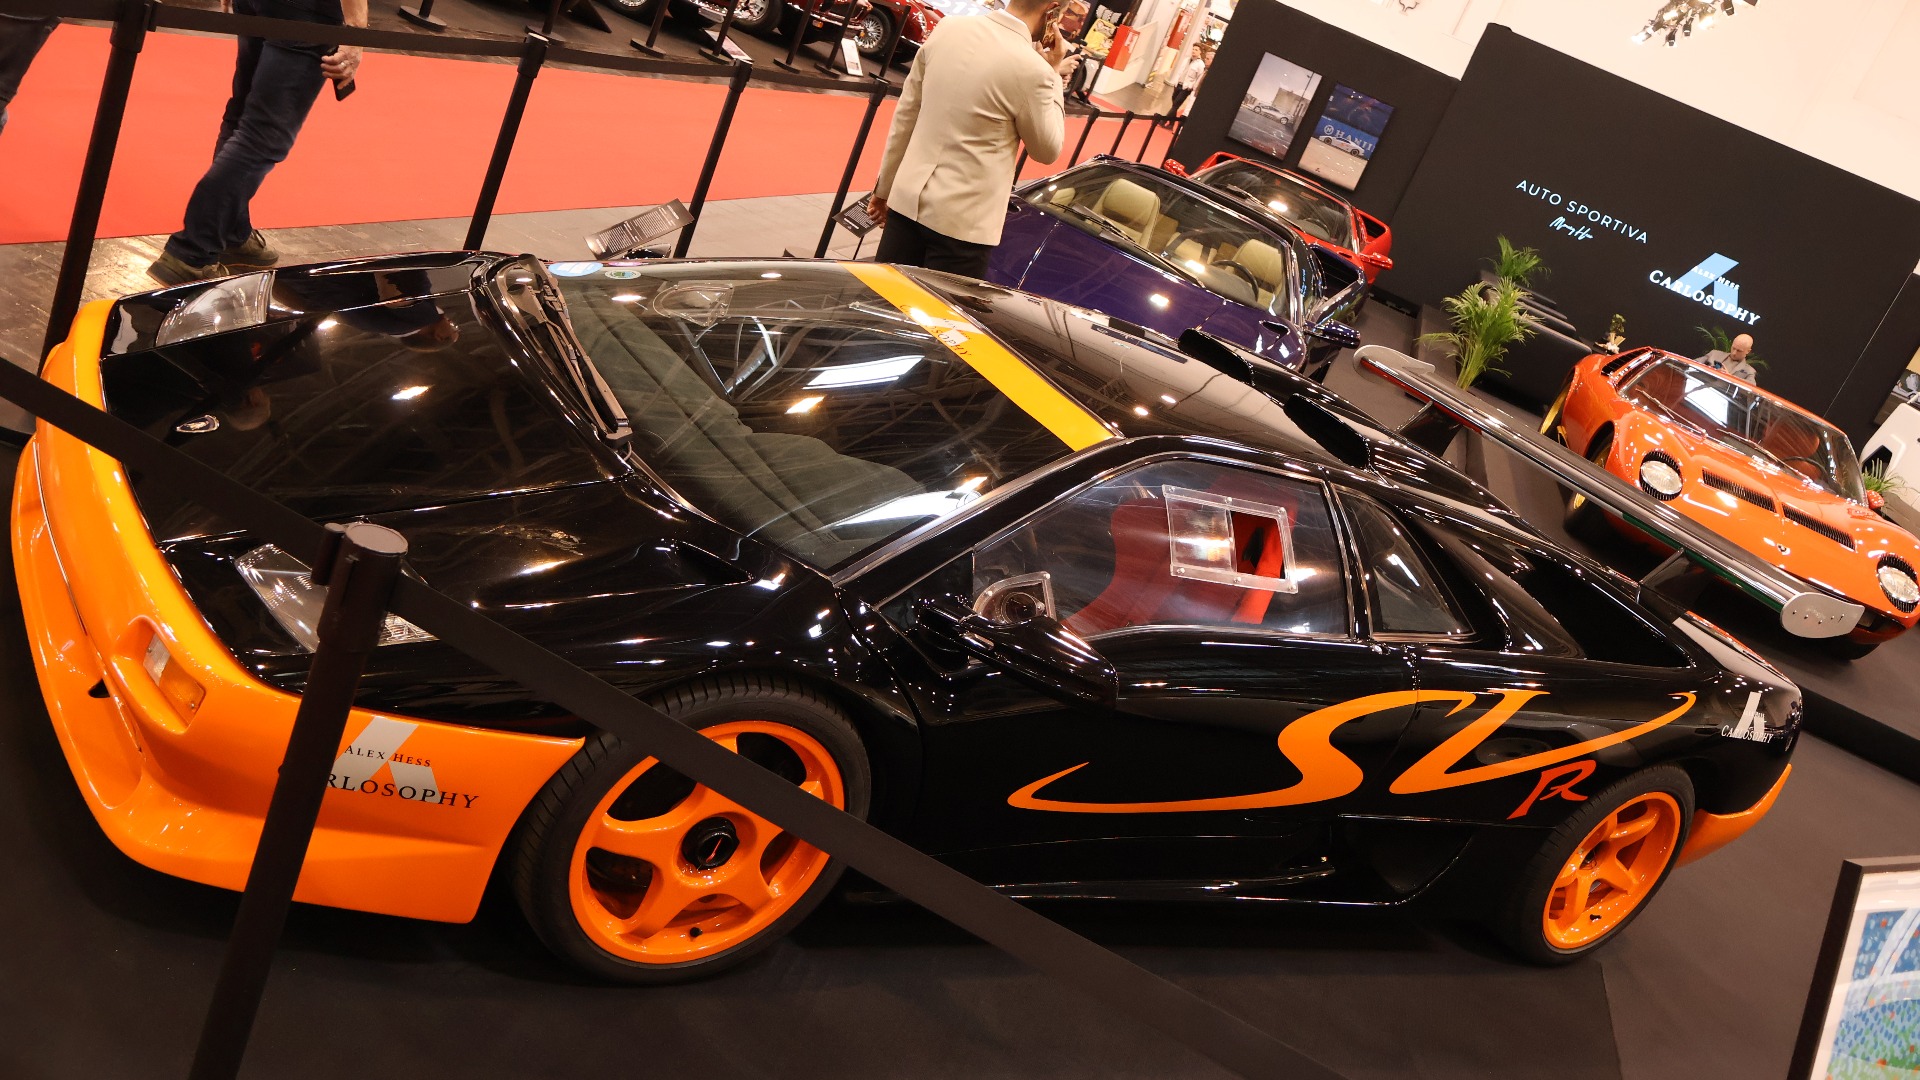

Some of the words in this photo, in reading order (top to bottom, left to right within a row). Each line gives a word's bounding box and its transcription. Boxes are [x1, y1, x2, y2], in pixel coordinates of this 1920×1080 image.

[1516, 180, 1561, 205] AUTO
[1566, 201, 1648, 244] SPORTIVA
[1649, 270, 1761, 325] CARLOSOPHY
[344, 745, 385, 760] ALEX
[393, 753, 431, 767] HESS
[327, 774, 479, 808] RLOSOPHY
